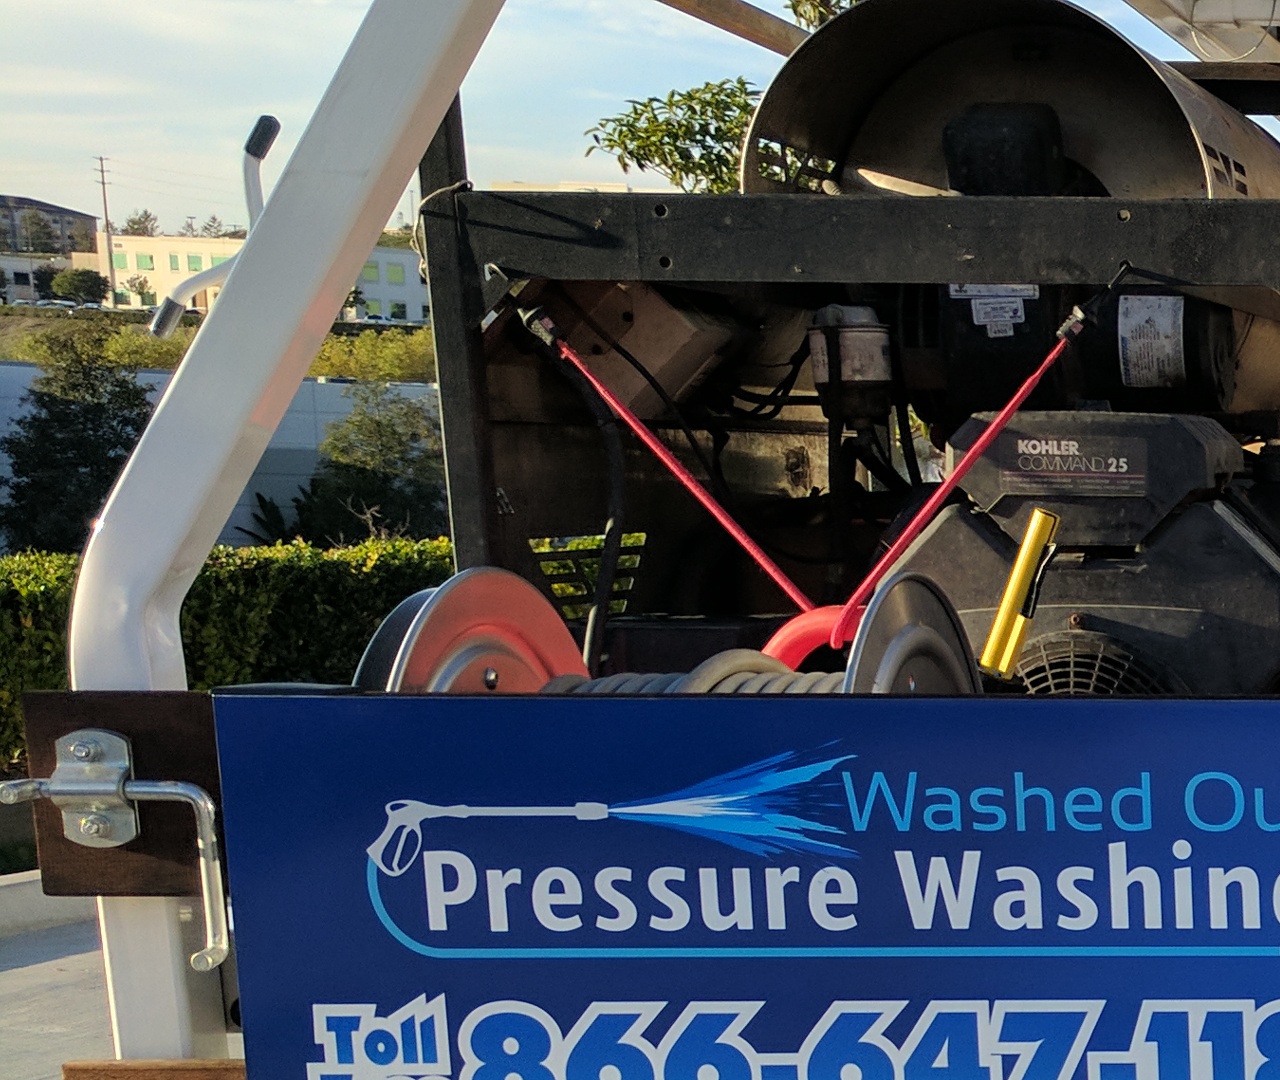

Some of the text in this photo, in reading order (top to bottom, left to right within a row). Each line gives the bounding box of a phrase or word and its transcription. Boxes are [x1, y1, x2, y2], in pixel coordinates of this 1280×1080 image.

[1017, 439, 1080, 455] KOHLER
[1107, 457, 1129, 473] 25
[842, 769, 1152, 835] Washed
[422, 847, 859, 935] Pressure
[311, 992, 451, 1076] Toll
